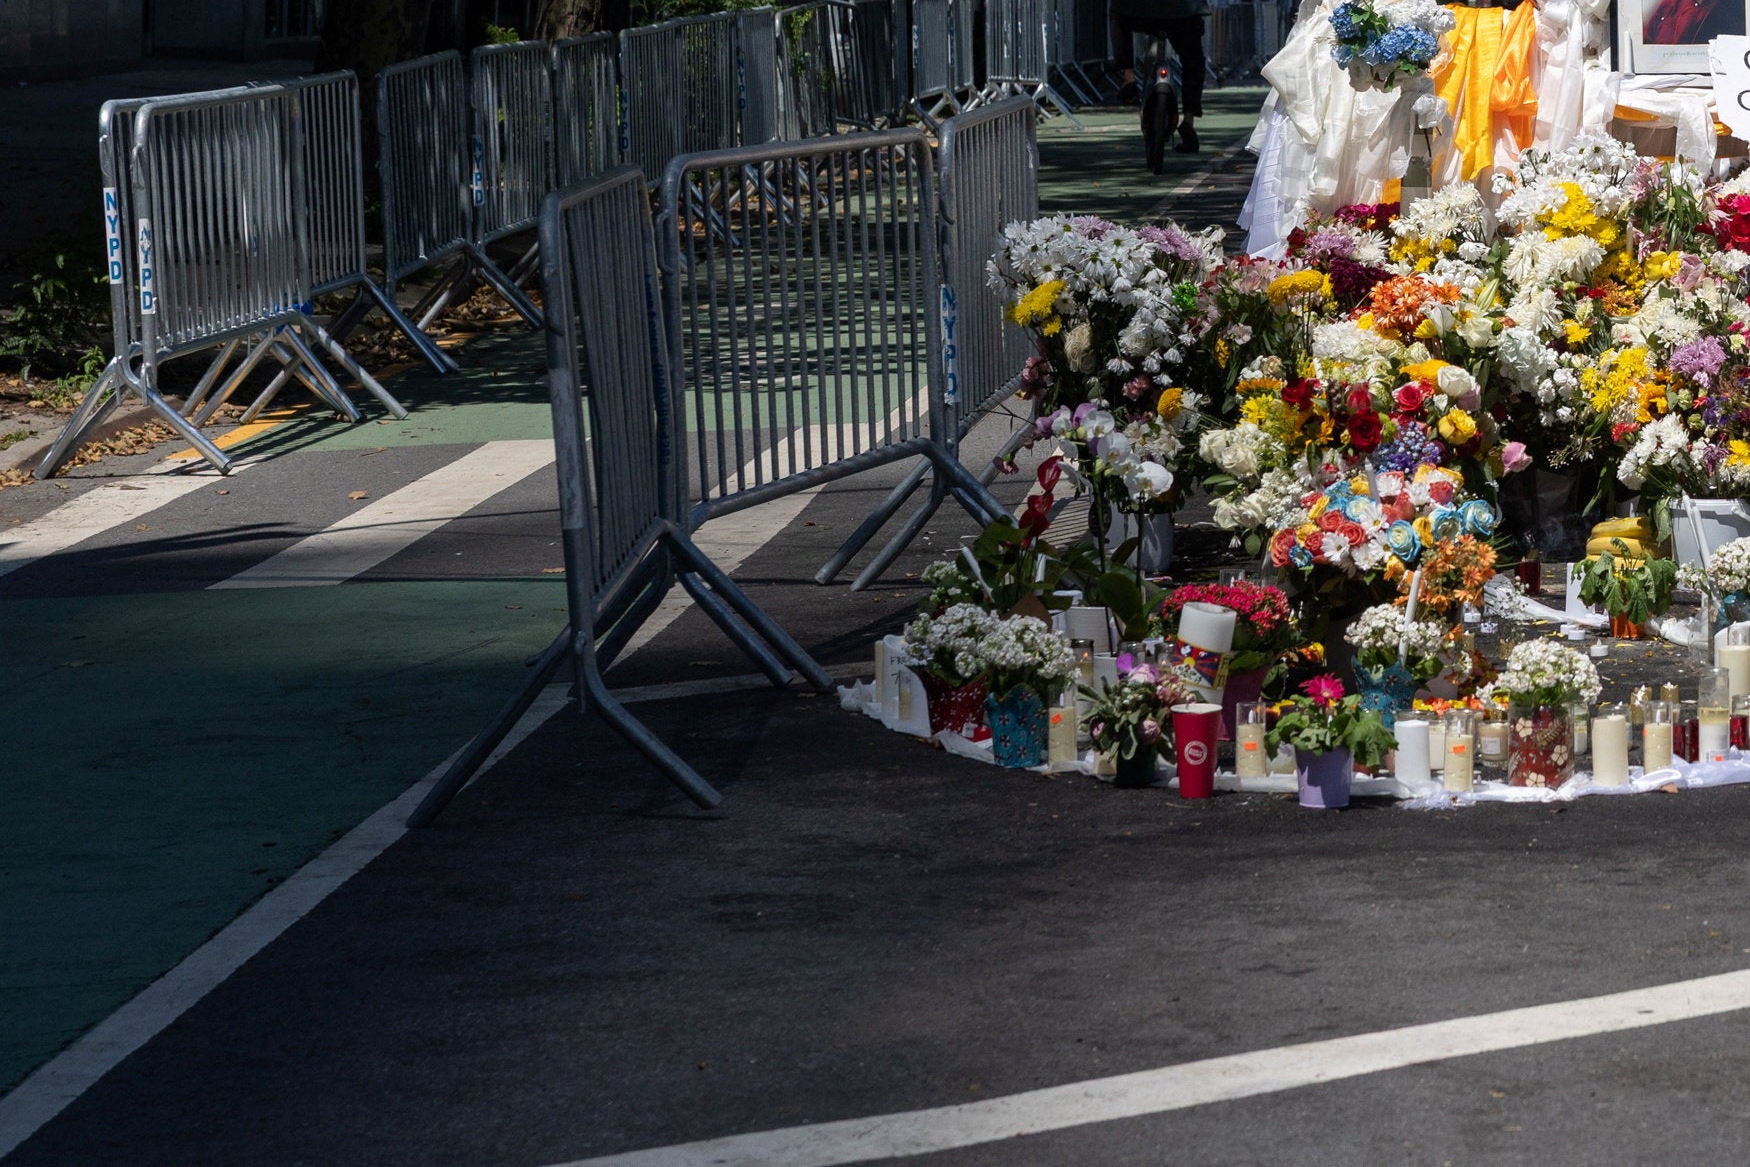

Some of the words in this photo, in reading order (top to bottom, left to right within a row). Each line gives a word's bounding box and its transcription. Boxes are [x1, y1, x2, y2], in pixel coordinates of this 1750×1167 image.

[473, 137, 484, 204] NYPD
[105, 191, 122, 280] NYPD
[140, 225, 153, 310] NYPD
